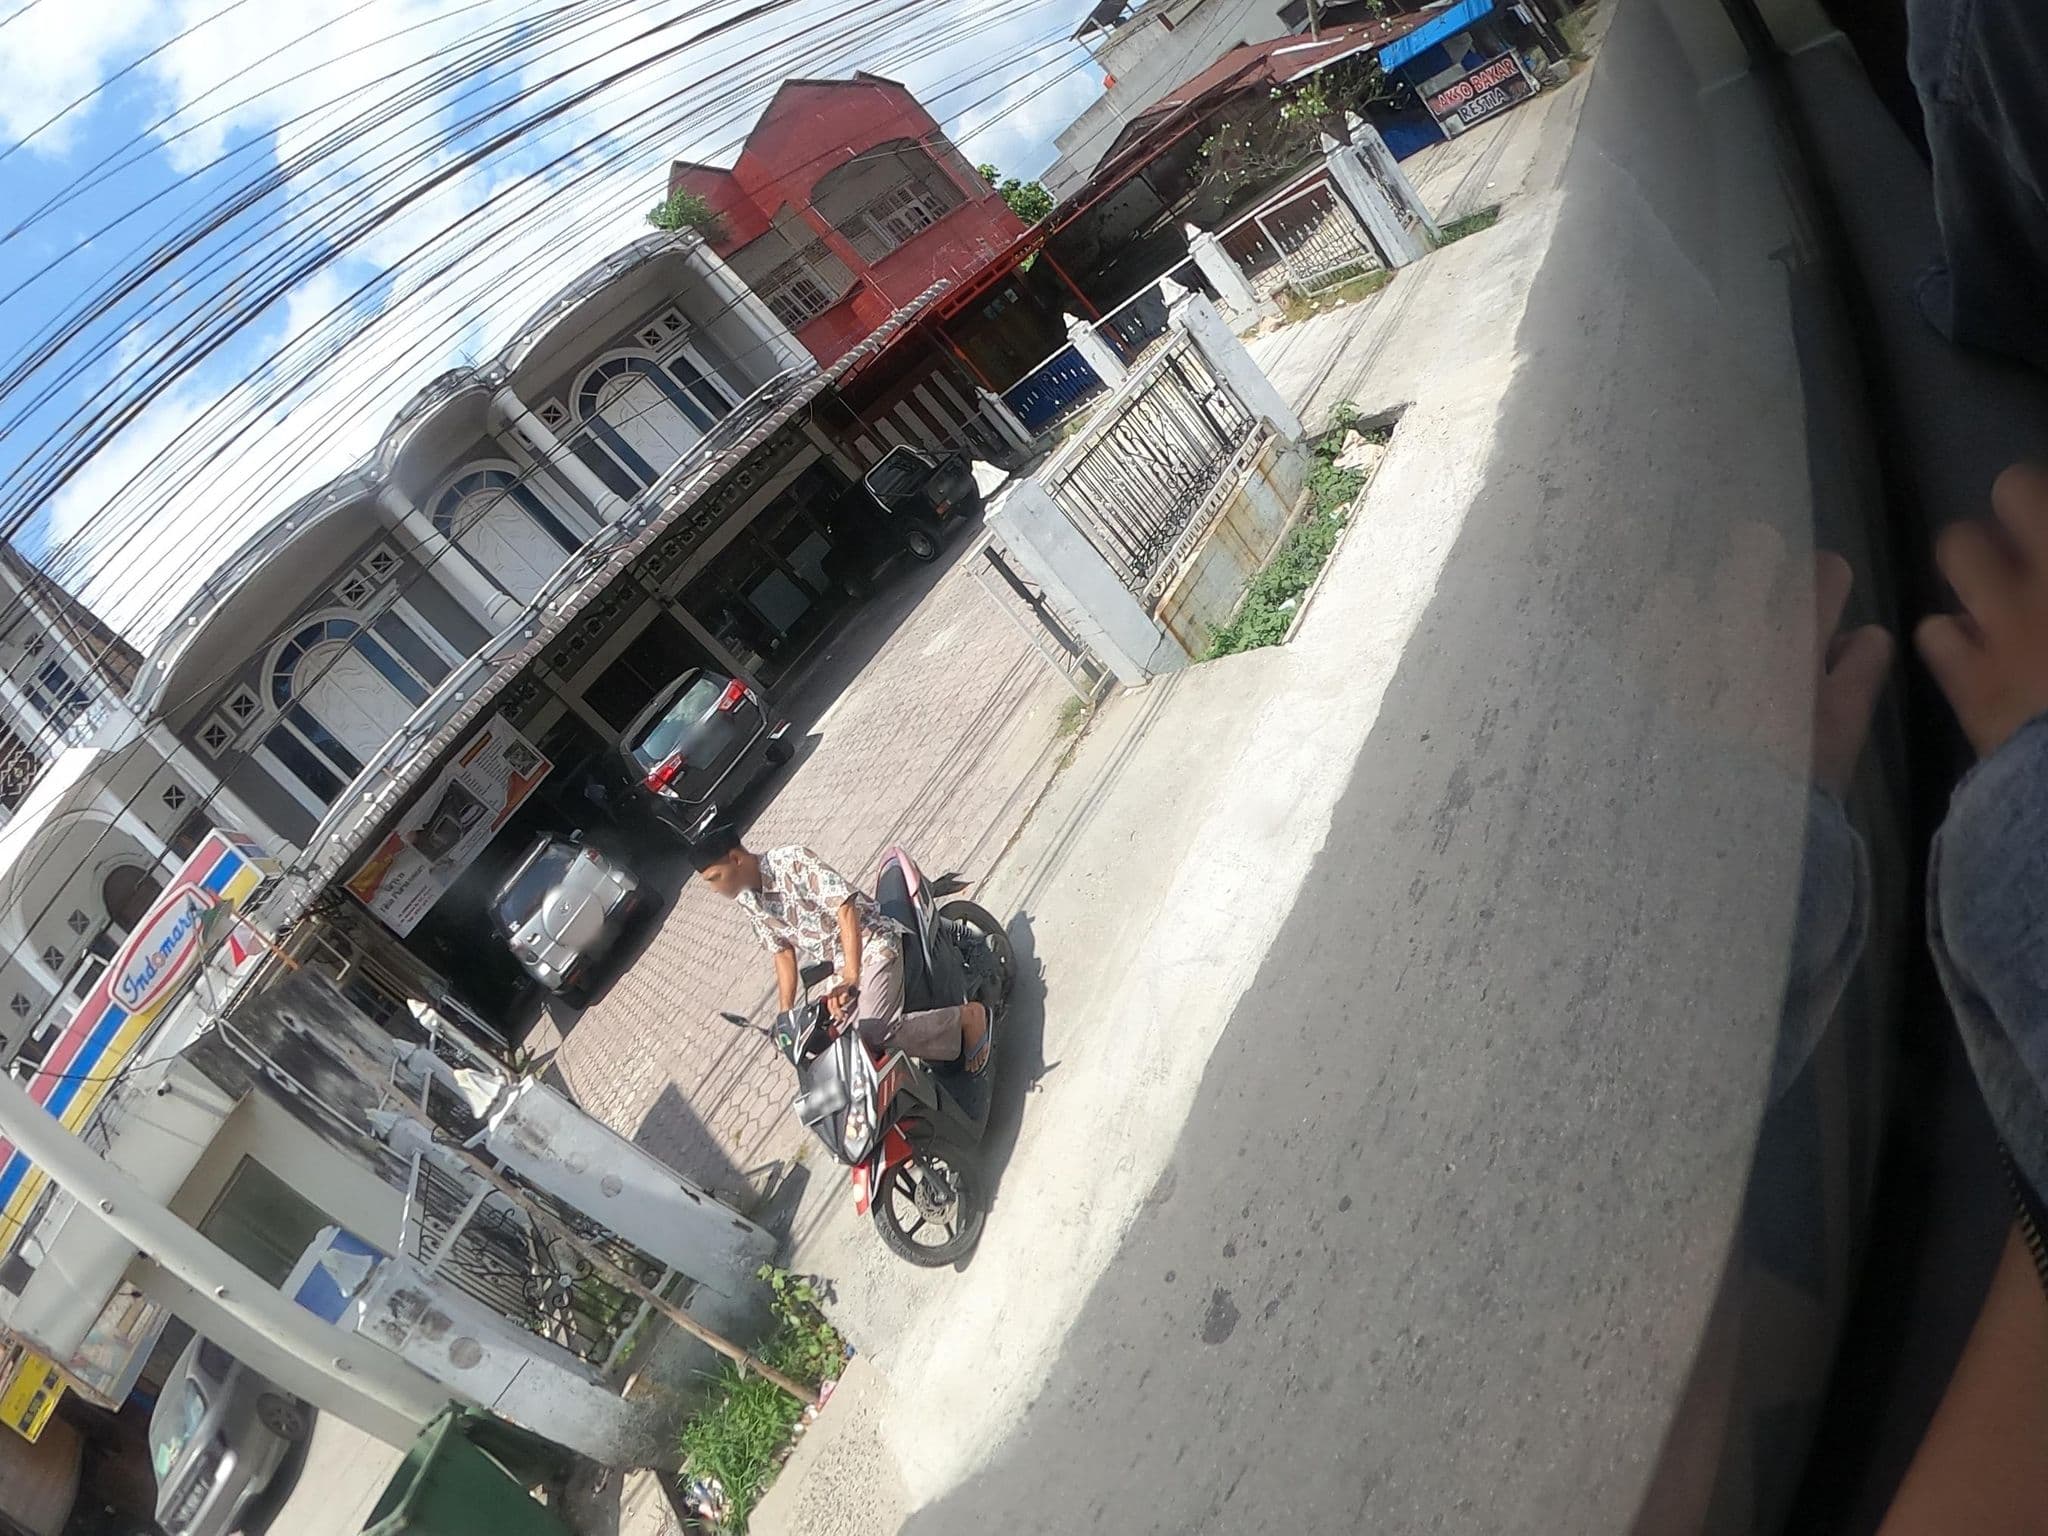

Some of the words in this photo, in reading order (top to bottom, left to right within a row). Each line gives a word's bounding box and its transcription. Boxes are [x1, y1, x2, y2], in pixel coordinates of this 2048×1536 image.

[1471, 58, 1519, 94] BAKAR
[1458, 88, 1507, 122] RESTIA
[122, 897, 202, 1003] Indomare
